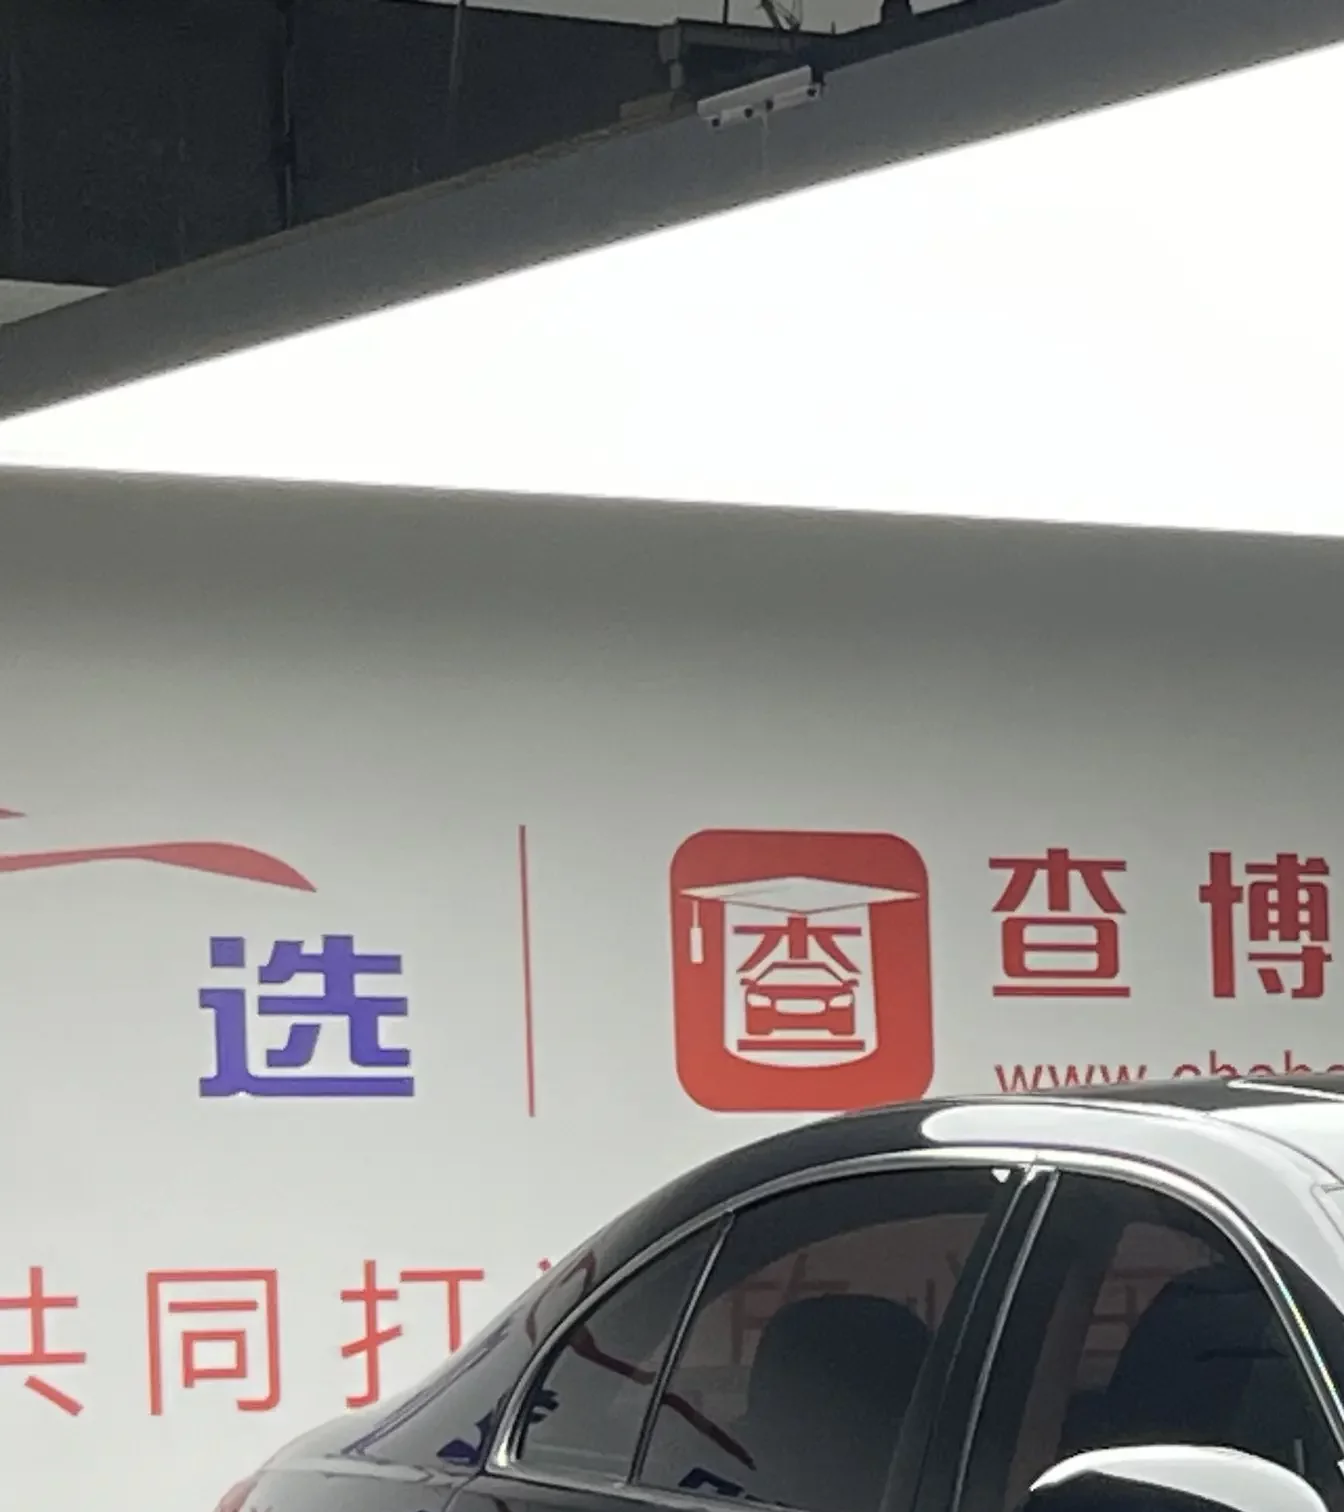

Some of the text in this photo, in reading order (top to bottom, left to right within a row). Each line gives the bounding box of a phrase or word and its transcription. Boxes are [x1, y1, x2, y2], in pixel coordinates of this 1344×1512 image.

[198, 934, 416, 1098] 选
[0, 1259, 552, 1417] 共同打
